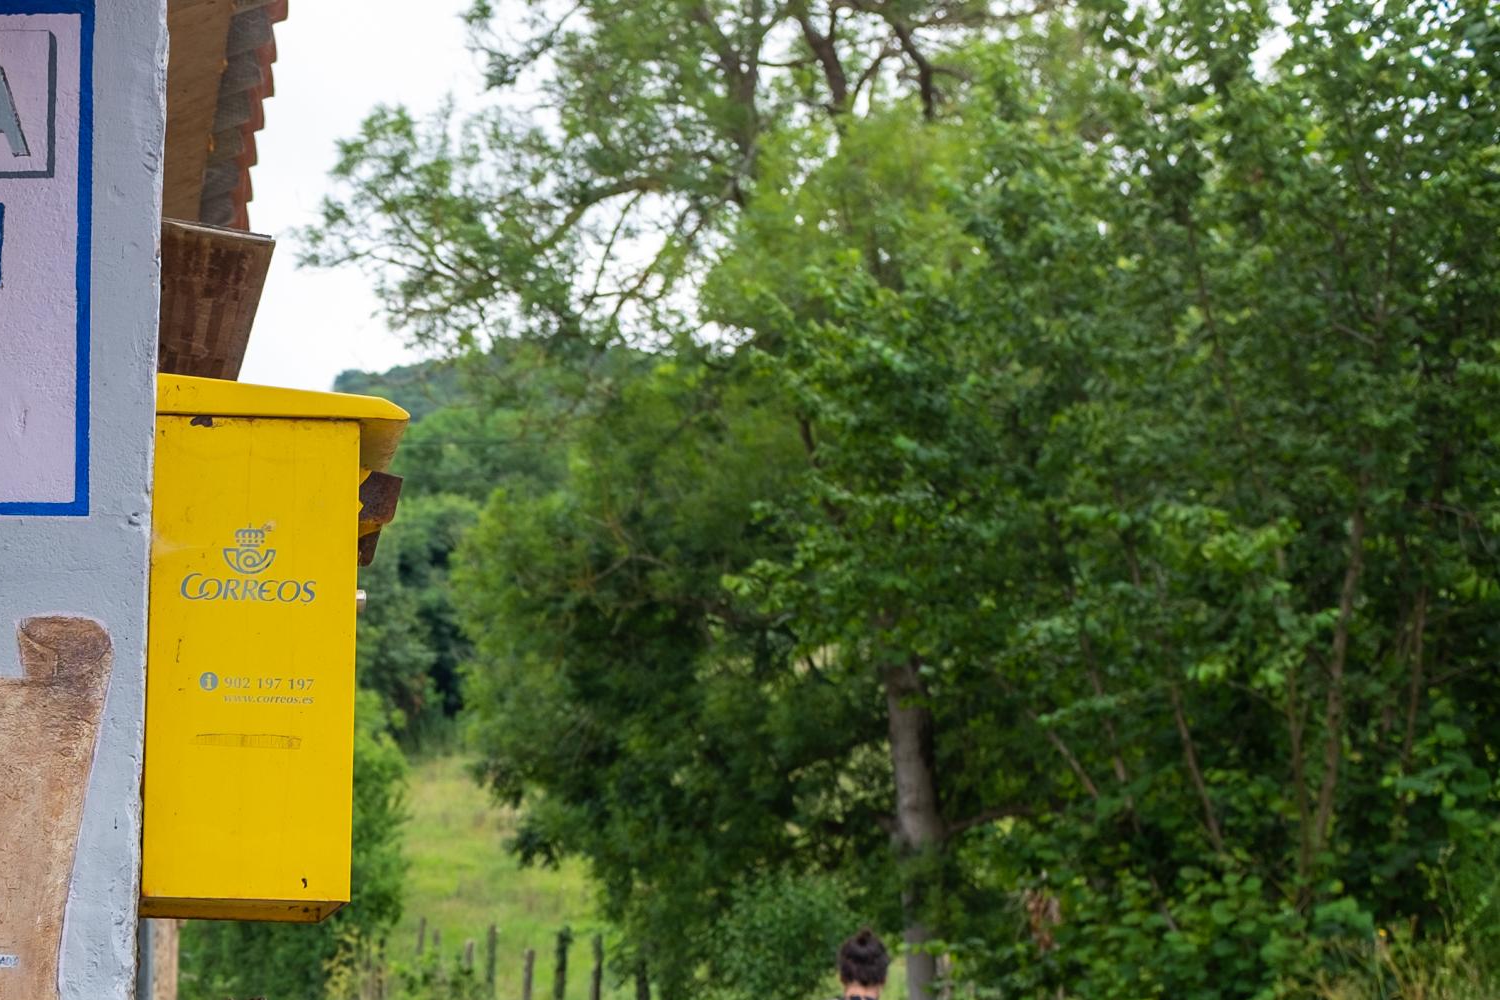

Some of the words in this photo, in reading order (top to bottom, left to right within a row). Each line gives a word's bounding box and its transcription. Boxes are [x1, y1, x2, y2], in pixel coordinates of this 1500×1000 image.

[224, 677, 250, 689] 902
[258, 678, 282, 690] 197
[288, 678, 315, 691] 197
[224, 694, 314, 705] www.correos.es
